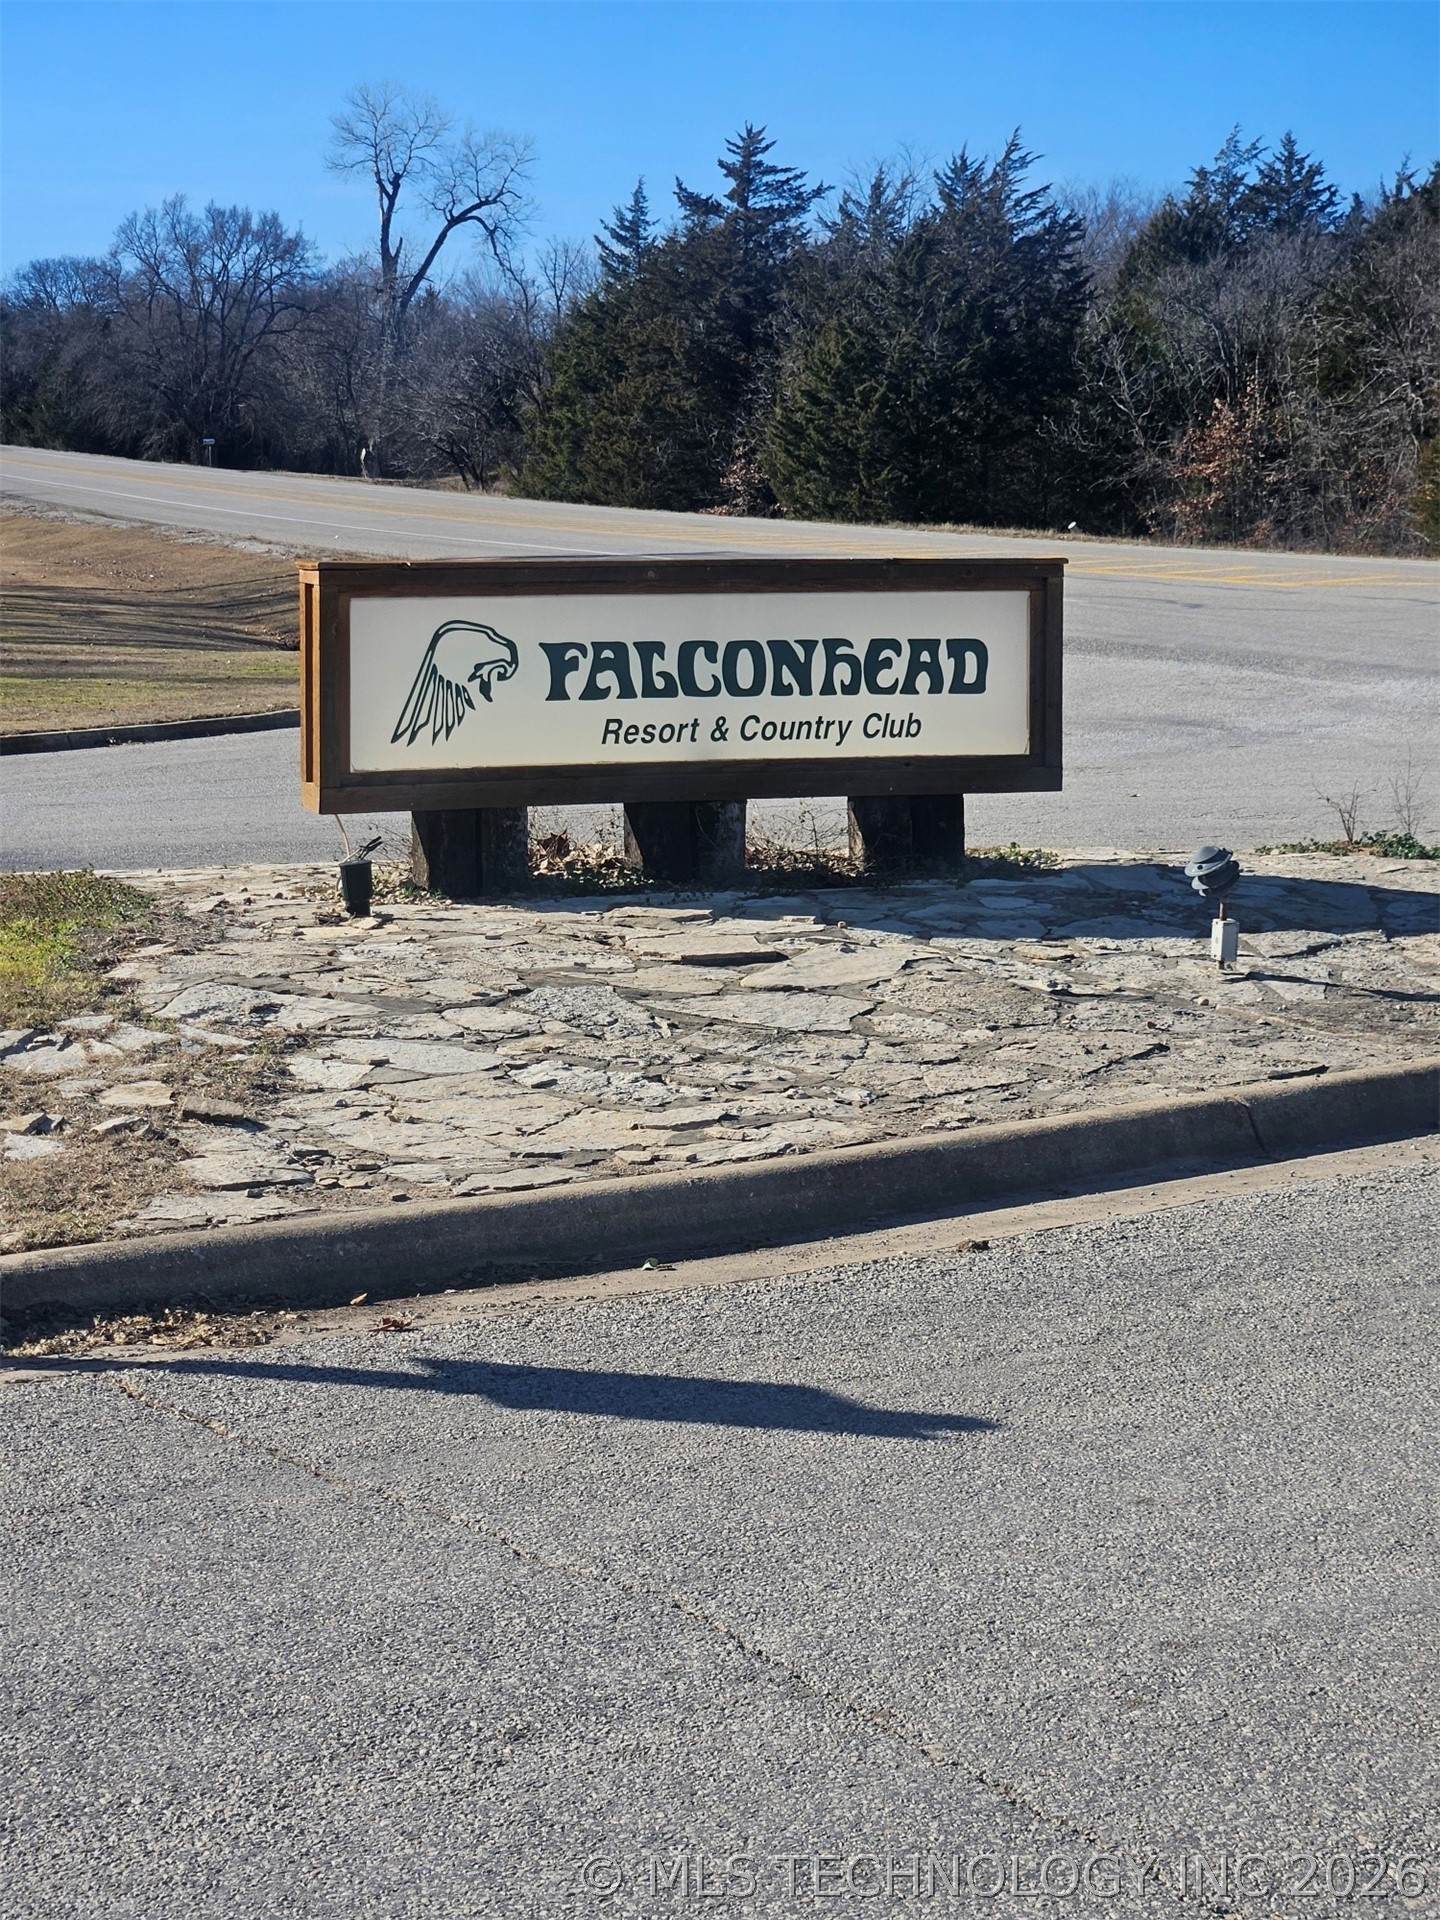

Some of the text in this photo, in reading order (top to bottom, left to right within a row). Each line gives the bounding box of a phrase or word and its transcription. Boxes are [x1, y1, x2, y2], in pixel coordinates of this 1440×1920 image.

[601, 712, 922, 747] Resort & Country Club
